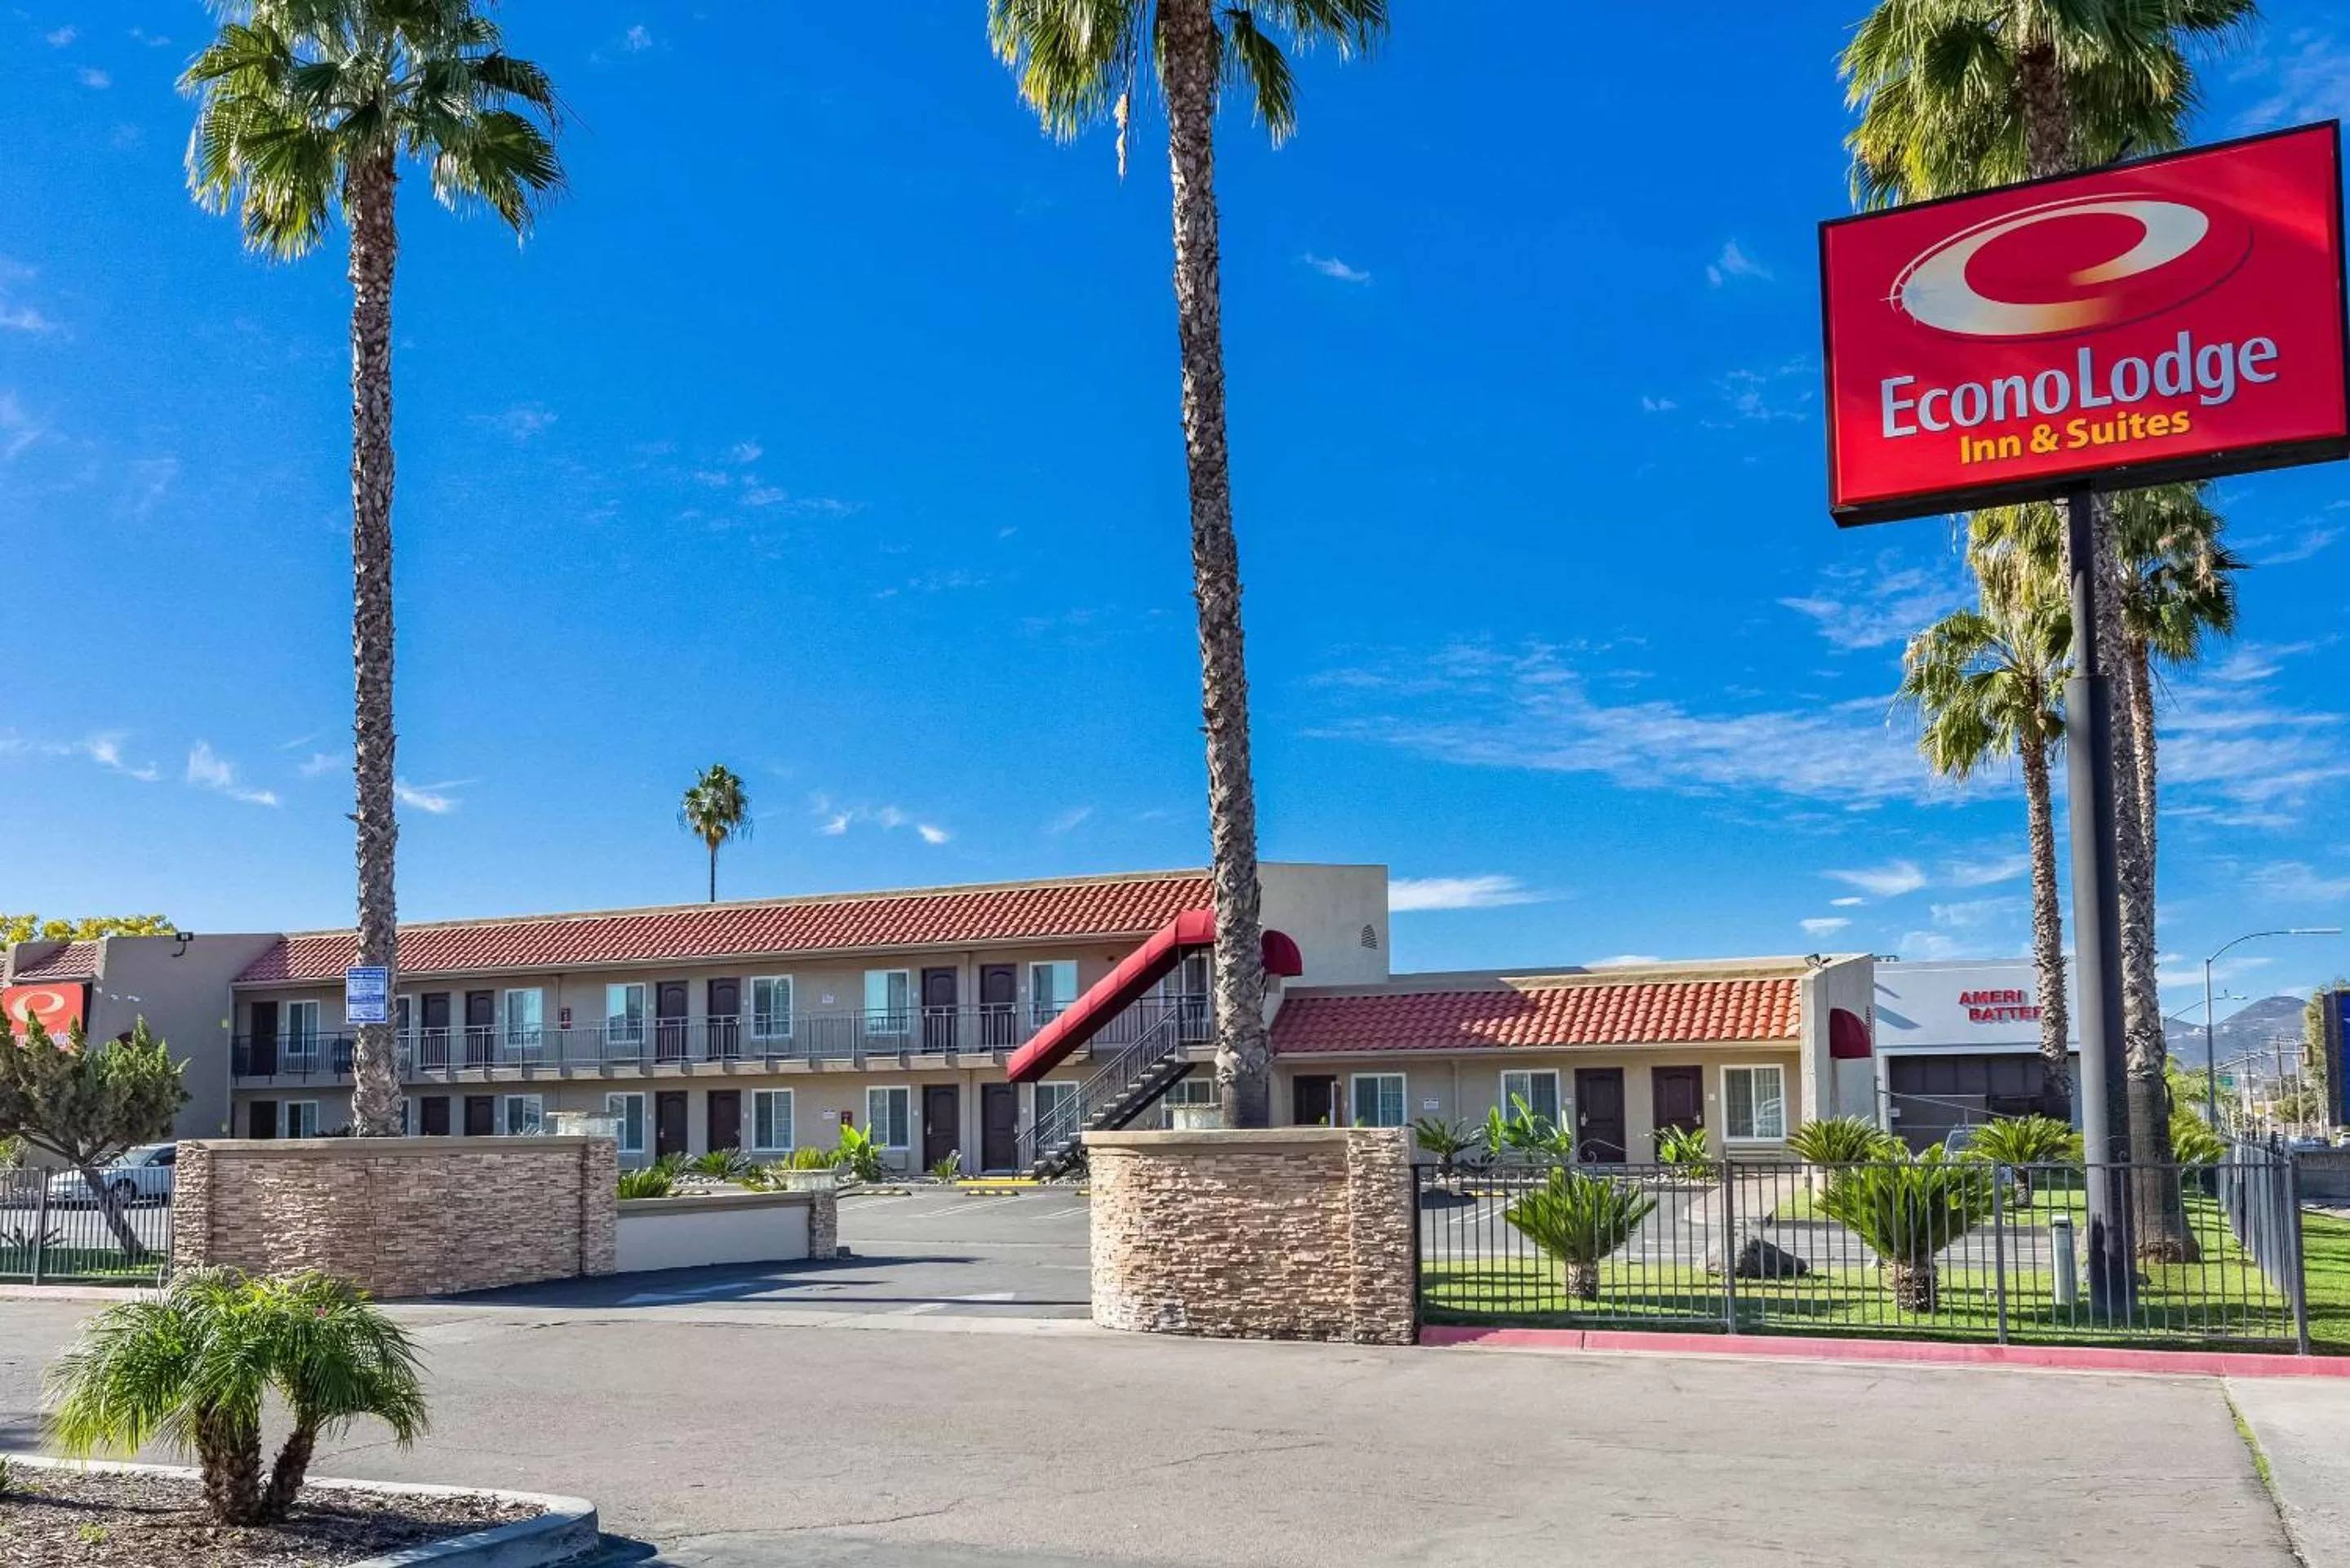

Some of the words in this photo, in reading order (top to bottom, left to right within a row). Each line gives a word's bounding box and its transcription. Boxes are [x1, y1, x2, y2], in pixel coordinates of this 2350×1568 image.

[1961, 434, 2021, 464] Inn
[2032, 424, 2059, 455] &
[2068, 410, 2192, 449] Suites
[1958, 989, 2022, 1005] AMERI
